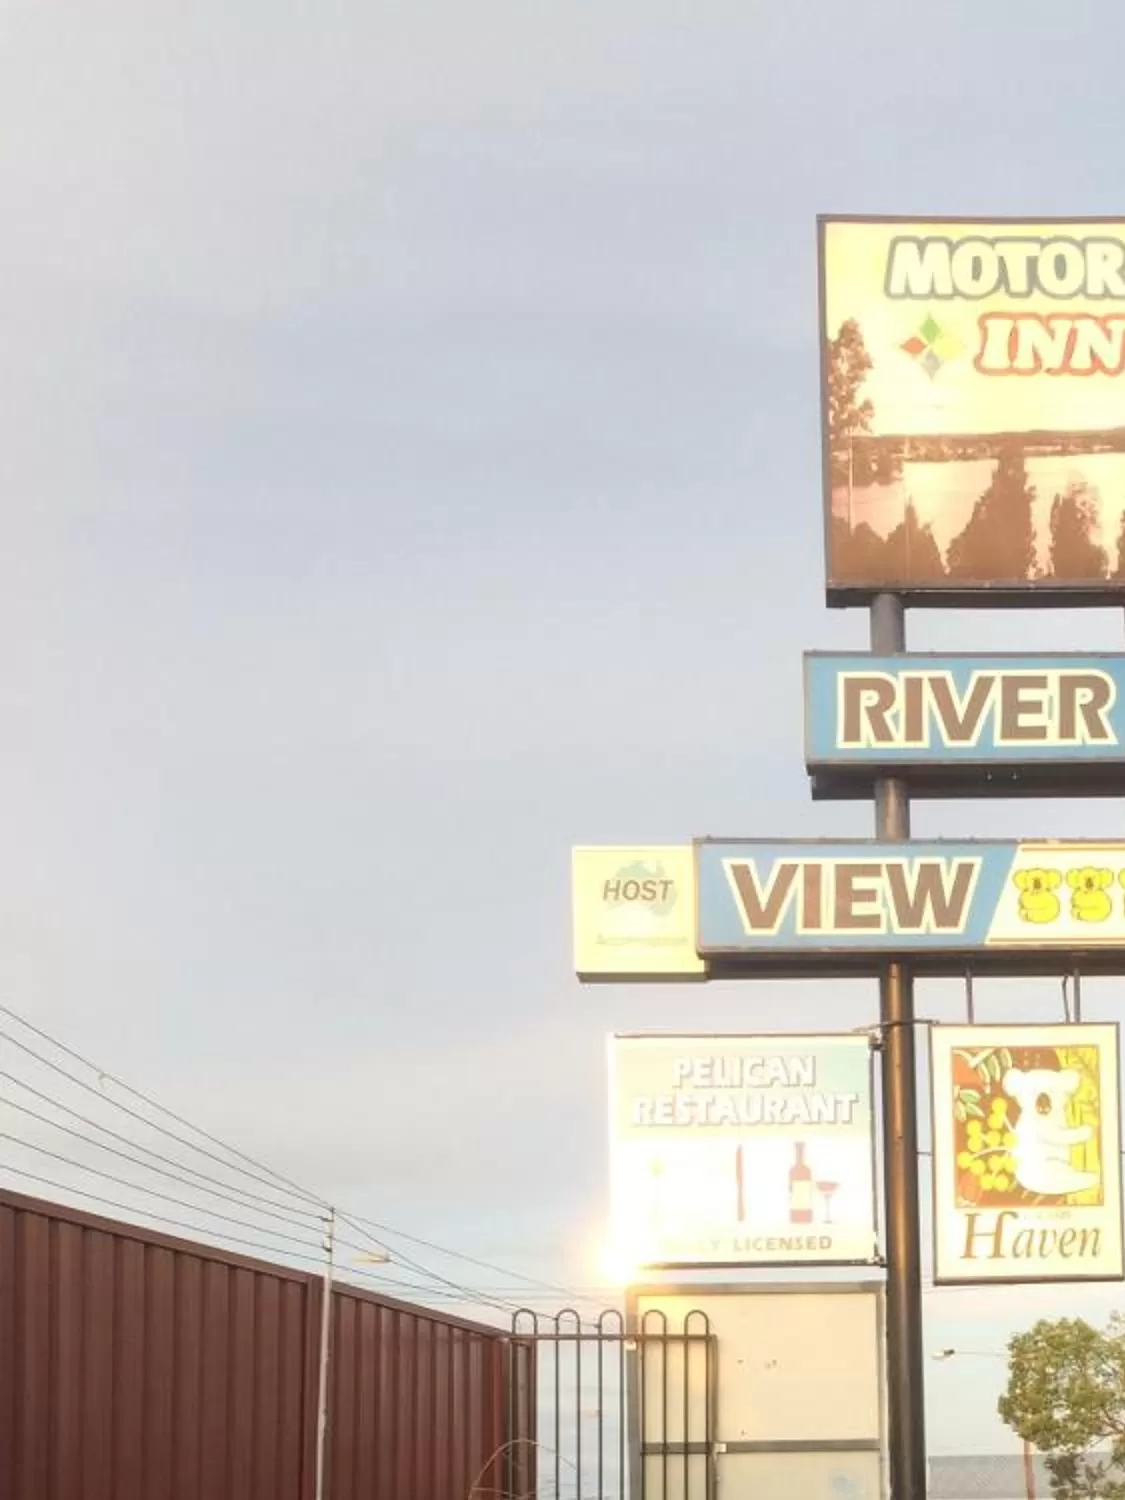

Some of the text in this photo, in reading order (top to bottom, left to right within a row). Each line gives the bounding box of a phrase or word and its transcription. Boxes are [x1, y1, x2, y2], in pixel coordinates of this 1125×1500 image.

[836, 669, 1118, 748] RIVER
[602, 879, 674, 902] HOST
[721, 856, 982, 935] VIEW
[672, 1055, 816, 1088] PELICAN
[630, 1092, 860, 1127] RESTAURANT
[733, 1235, 833, 1252] LICENSED
[960, 1211, 1101, 1260] Haven
